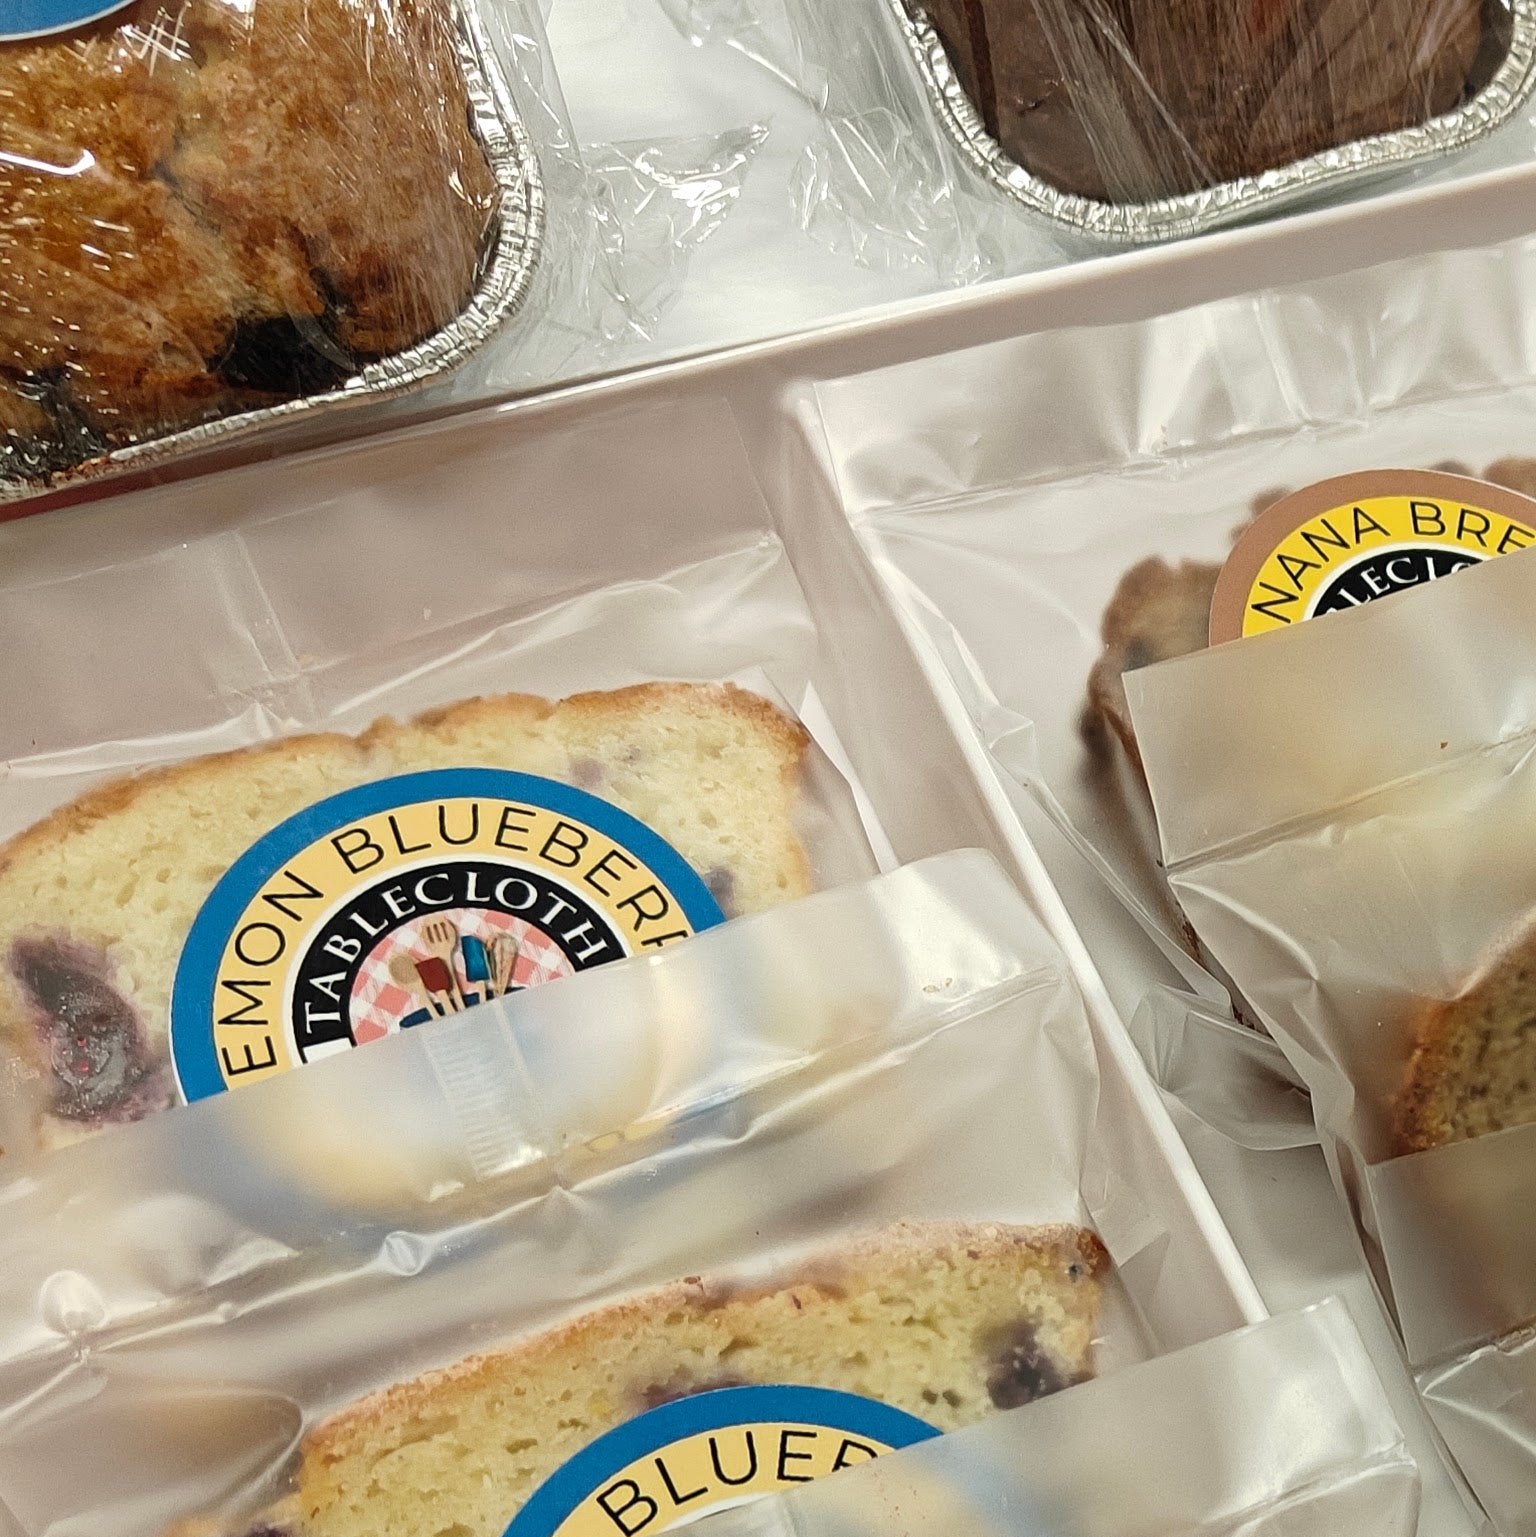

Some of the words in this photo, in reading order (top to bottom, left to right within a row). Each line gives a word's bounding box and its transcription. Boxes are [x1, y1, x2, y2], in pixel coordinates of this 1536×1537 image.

[1251, 507, 1391, 624] NANA
[218, 869, 325, 1076] EMON
[305, 871, 610, 1033] TABLECLOTH
